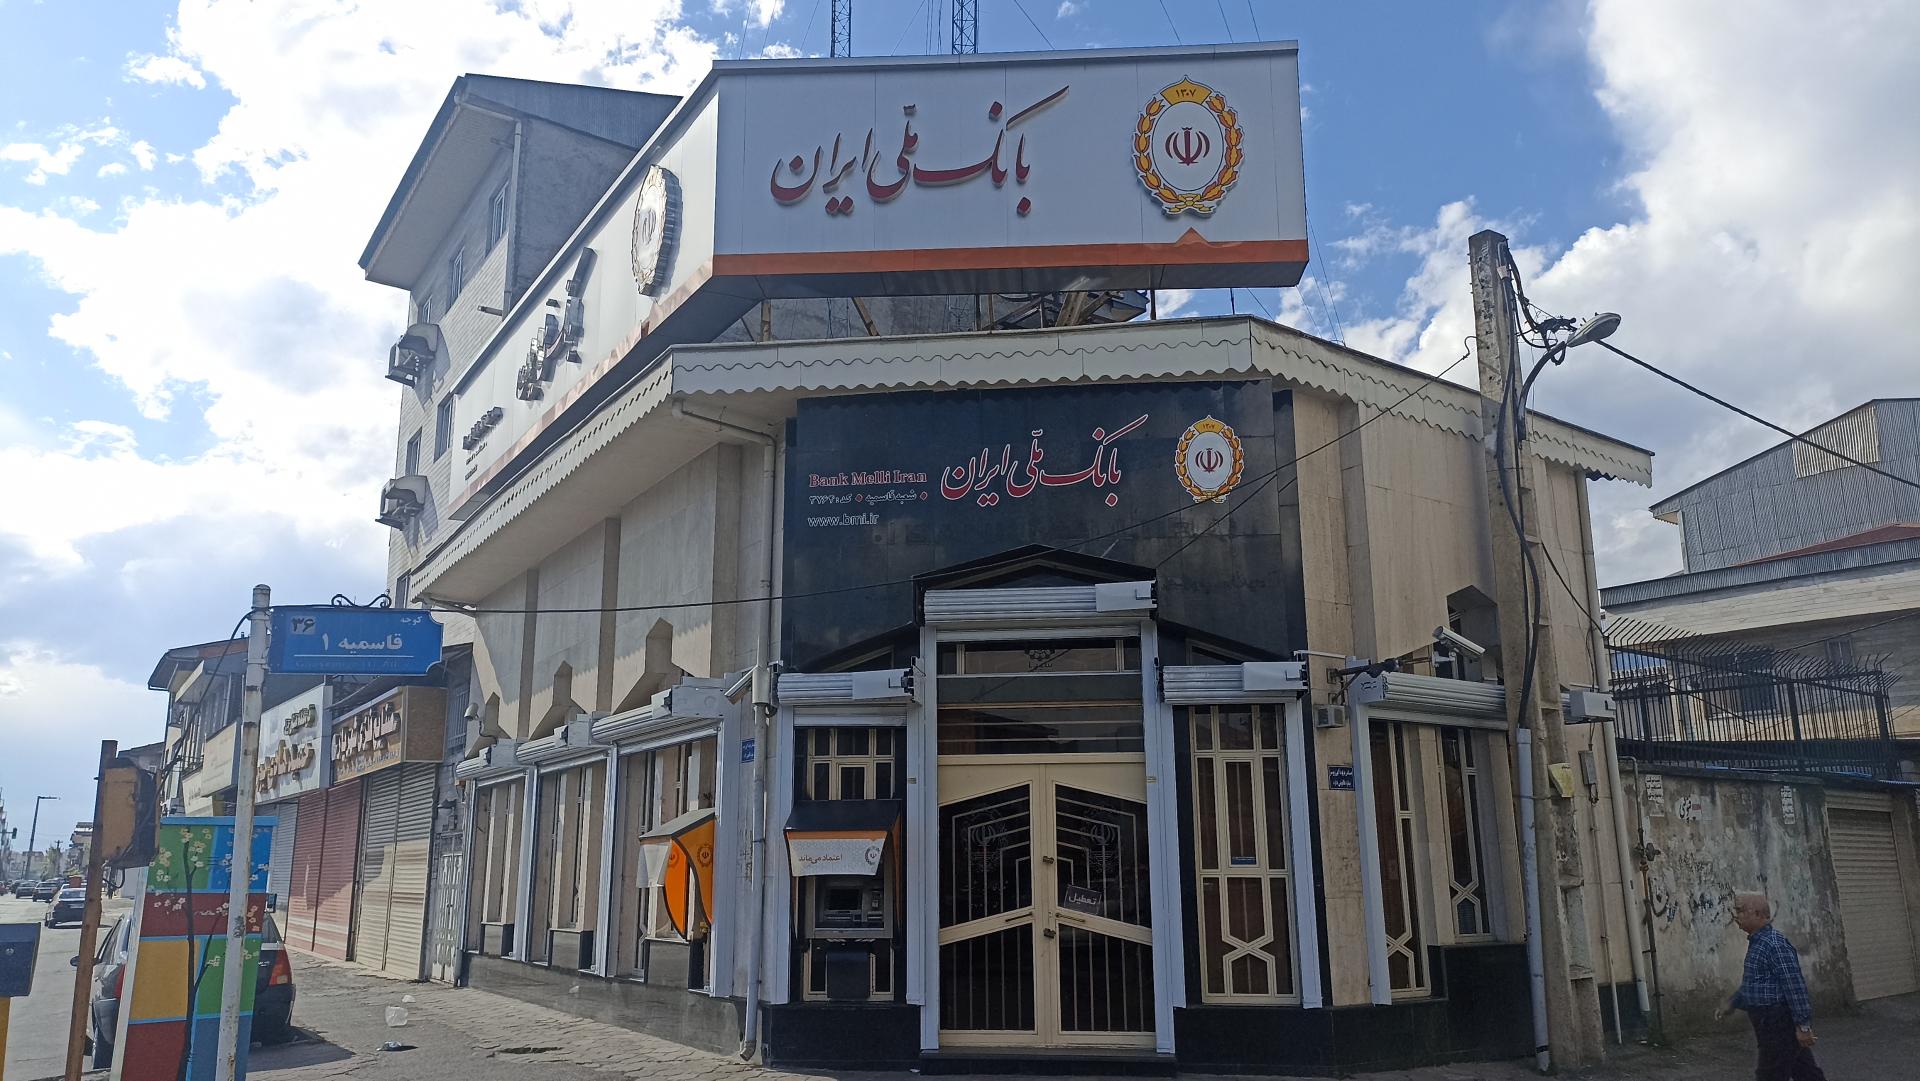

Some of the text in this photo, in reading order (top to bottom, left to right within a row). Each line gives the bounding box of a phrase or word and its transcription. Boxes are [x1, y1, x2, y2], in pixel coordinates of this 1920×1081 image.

[1176, 87, 1197, 98] ۱۳۰۷
[913, 85, 1070, 217] بانک
[770, 127, 873, 218] ایران
[1039, 413, 1149, 507] بانک
[808, 469, 928, 487] Bank Melli Iran
[941, 444, 1012, 507] ایران
[807, 512, 880, 527] www.bmi.ir
[291, 616, 316, 633] ۳۶
[321, 632, 404, 655] قاسمیه ۱
[823, 853, 842, 863] اعتماد
[1068, 892, 1098, 906] تعطیل
